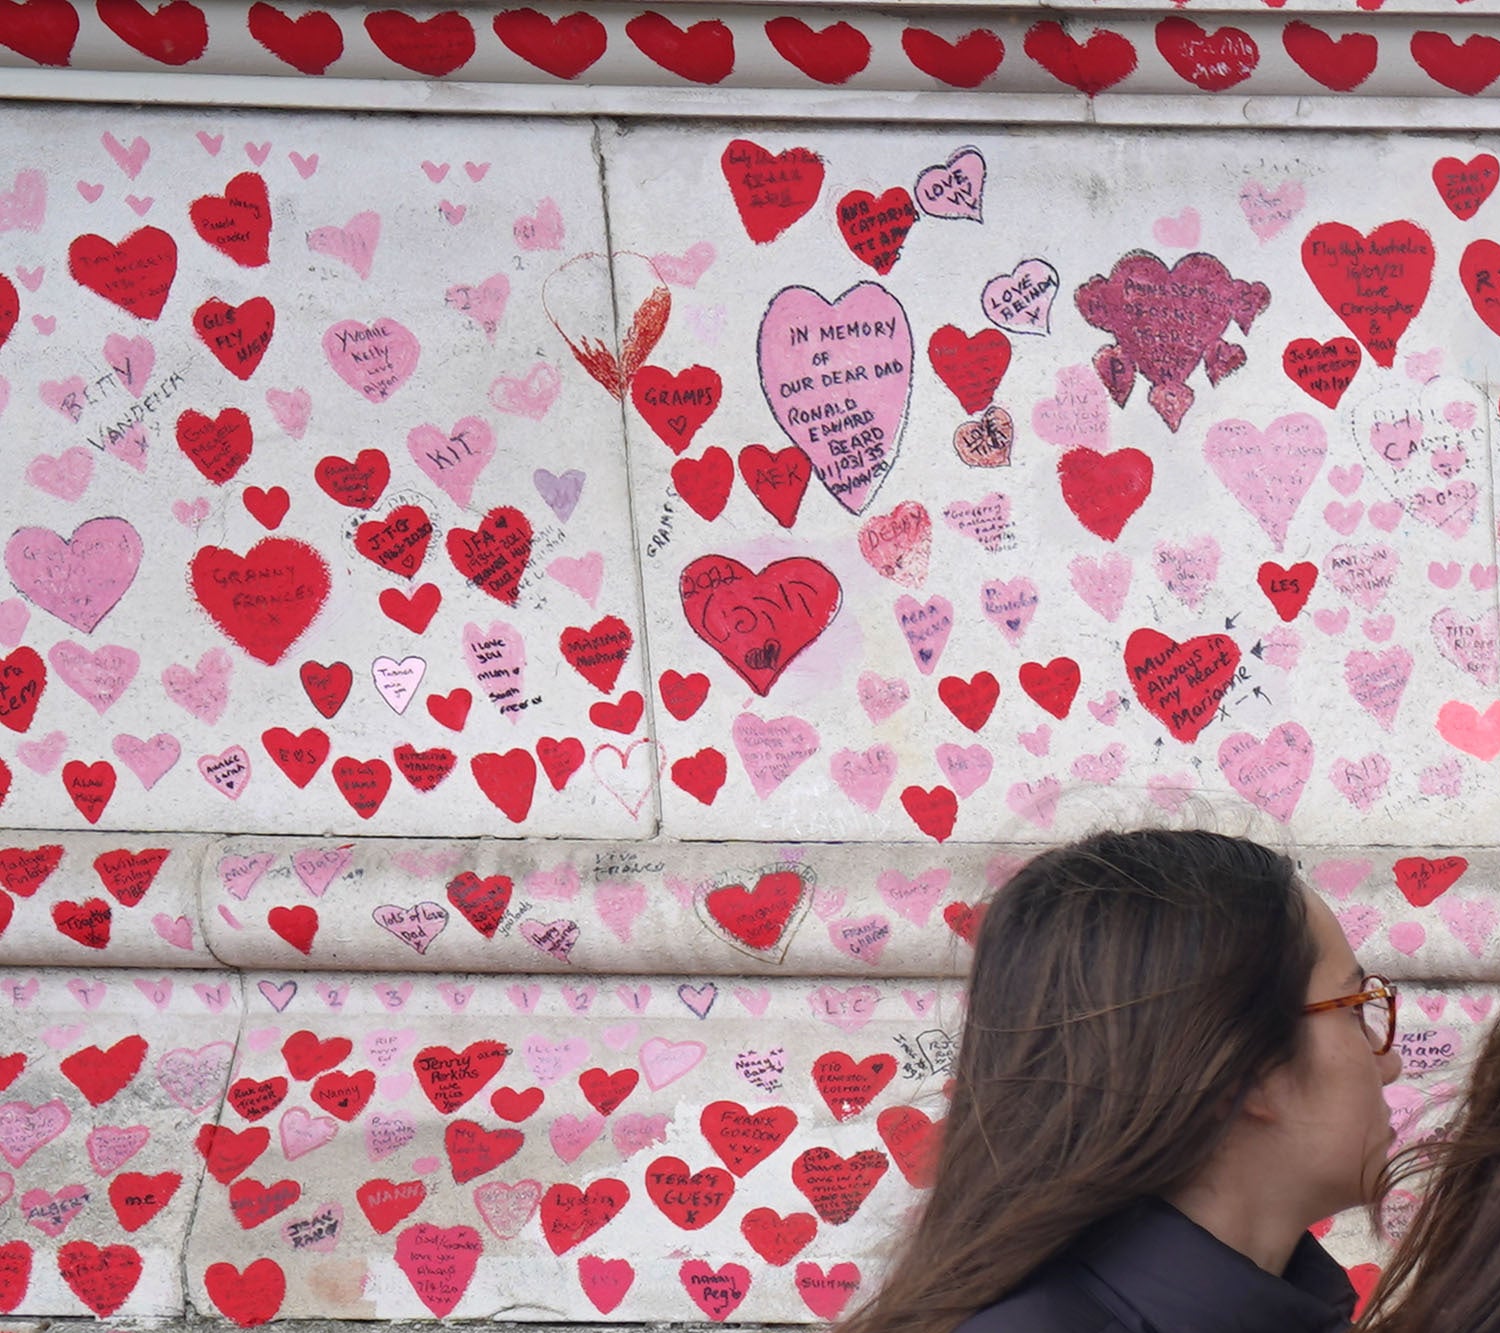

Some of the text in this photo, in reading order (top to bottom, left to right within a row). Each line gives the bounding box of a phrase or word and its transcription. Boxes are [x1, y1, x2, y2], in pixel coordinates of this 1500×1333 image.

[926, 169, 967, 201] LOVE
[991, 275, 1032, 308] LOVE
[791, 317, 895, 345] IN MEMORY
[812, 351, 830, 366] OF
[780, 359, 904, 398] OUR DEAR DAD
[644, 387, 713, 406] GRAMPS
[787, 398, 857, 426] RONALD
[809, 409, 874, 443] EDWARD
[426, 431, 474, 471] KIT
[721, 1111, 778, 1128] FRANK
[721, 1128, 782, 1141] GORDON
[664, 1191, 725, 1207] GUEST
